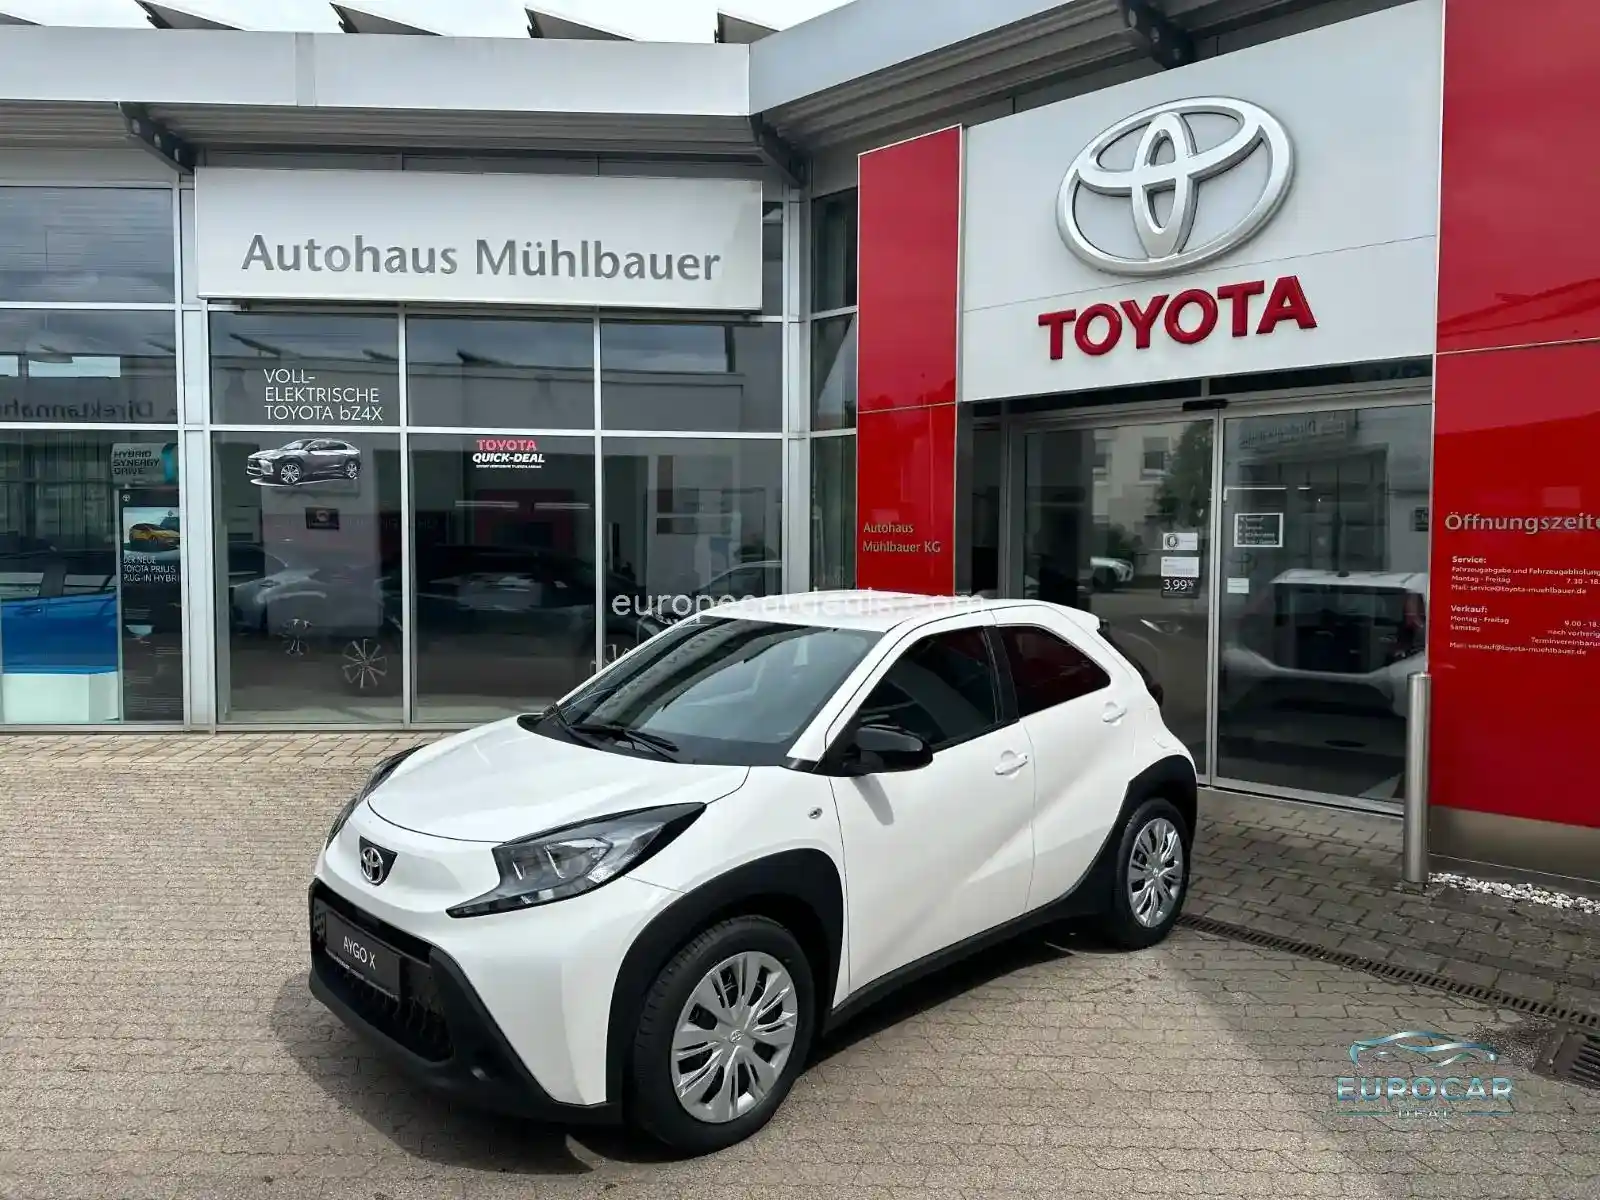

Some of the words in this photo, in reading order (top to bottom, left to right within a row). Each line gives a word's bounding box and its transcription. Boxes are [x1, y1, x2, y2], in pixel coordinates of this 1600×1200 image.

[242, 233, 458, 276] Autohaus
[476, 238, 721, 281] Mühlbauer
[1038, 275, 1317, 360] TOYOTA
[263, 368, 316, 384] VOLL-
[264, 386, 380, 403] ELEKTRISCHE
[263, 404, 334, 420] TOYOTA
[339, 404, 384, 421] bZ4X
[475, 439, 538, 452] TOYOTA
[113, 450, 152, 458] HYBRID
[471, 452, 546, 464] QUICK-DEAL
[112, 458, 160, 467] SYNERGY
[113, 467, 146, 475] DRIVE
[863, 521, 914, 533] Autohaus
[862, 540, 921, 553] Mühlbauer
[924, 540, 942, 553] KG
[1451, 555, 1487, 564] Service:
[151, 564, 176, 573] PRIUS
[1512, 567, 1528, 575] und
[153, 573, 180, 582] HYBRI
[1451, 575, 1479, 583] Montag
[1485, 576, 1511, 584] Freitag
[1450, 604, 1488, 613] Verkauf:
[1450, 615, 1478, 623] Montag
[1483, 616, 1510, 625] Freitag
[343, 935, 367, 963] AYGO
[369, 951, 376, 970] X
